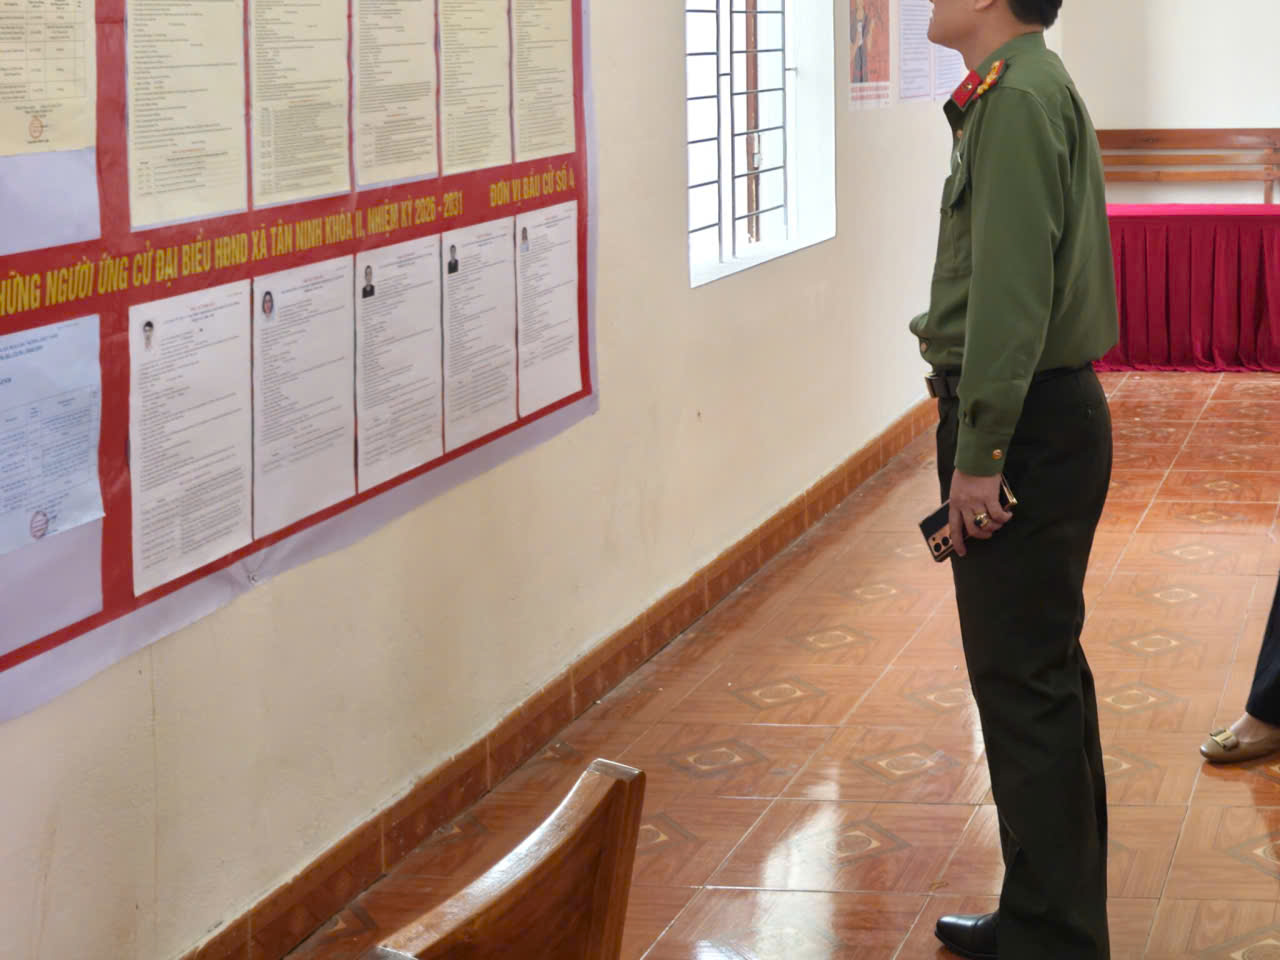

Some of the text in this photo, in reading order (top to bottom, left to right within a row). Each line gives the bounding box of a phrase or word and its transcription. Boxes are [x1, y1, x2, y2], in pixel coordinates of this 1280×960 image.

[46, 255, 94, 307] NGƯỜI
[98, 252, 129, 295] ỨNG
[132, 239, 154, 288] CỬ
[155, 246, 179, 288] ĐẠI
[182, 227, 211, 277] BIỂU
[251, 223, 268, 261] XÃ
[270, 218, 292, 257] TÂN
[367, 199, 399, 239] NHIỆM
[415, 196, 436, 224] 2026
[443, 191, 463, 218] 2031
